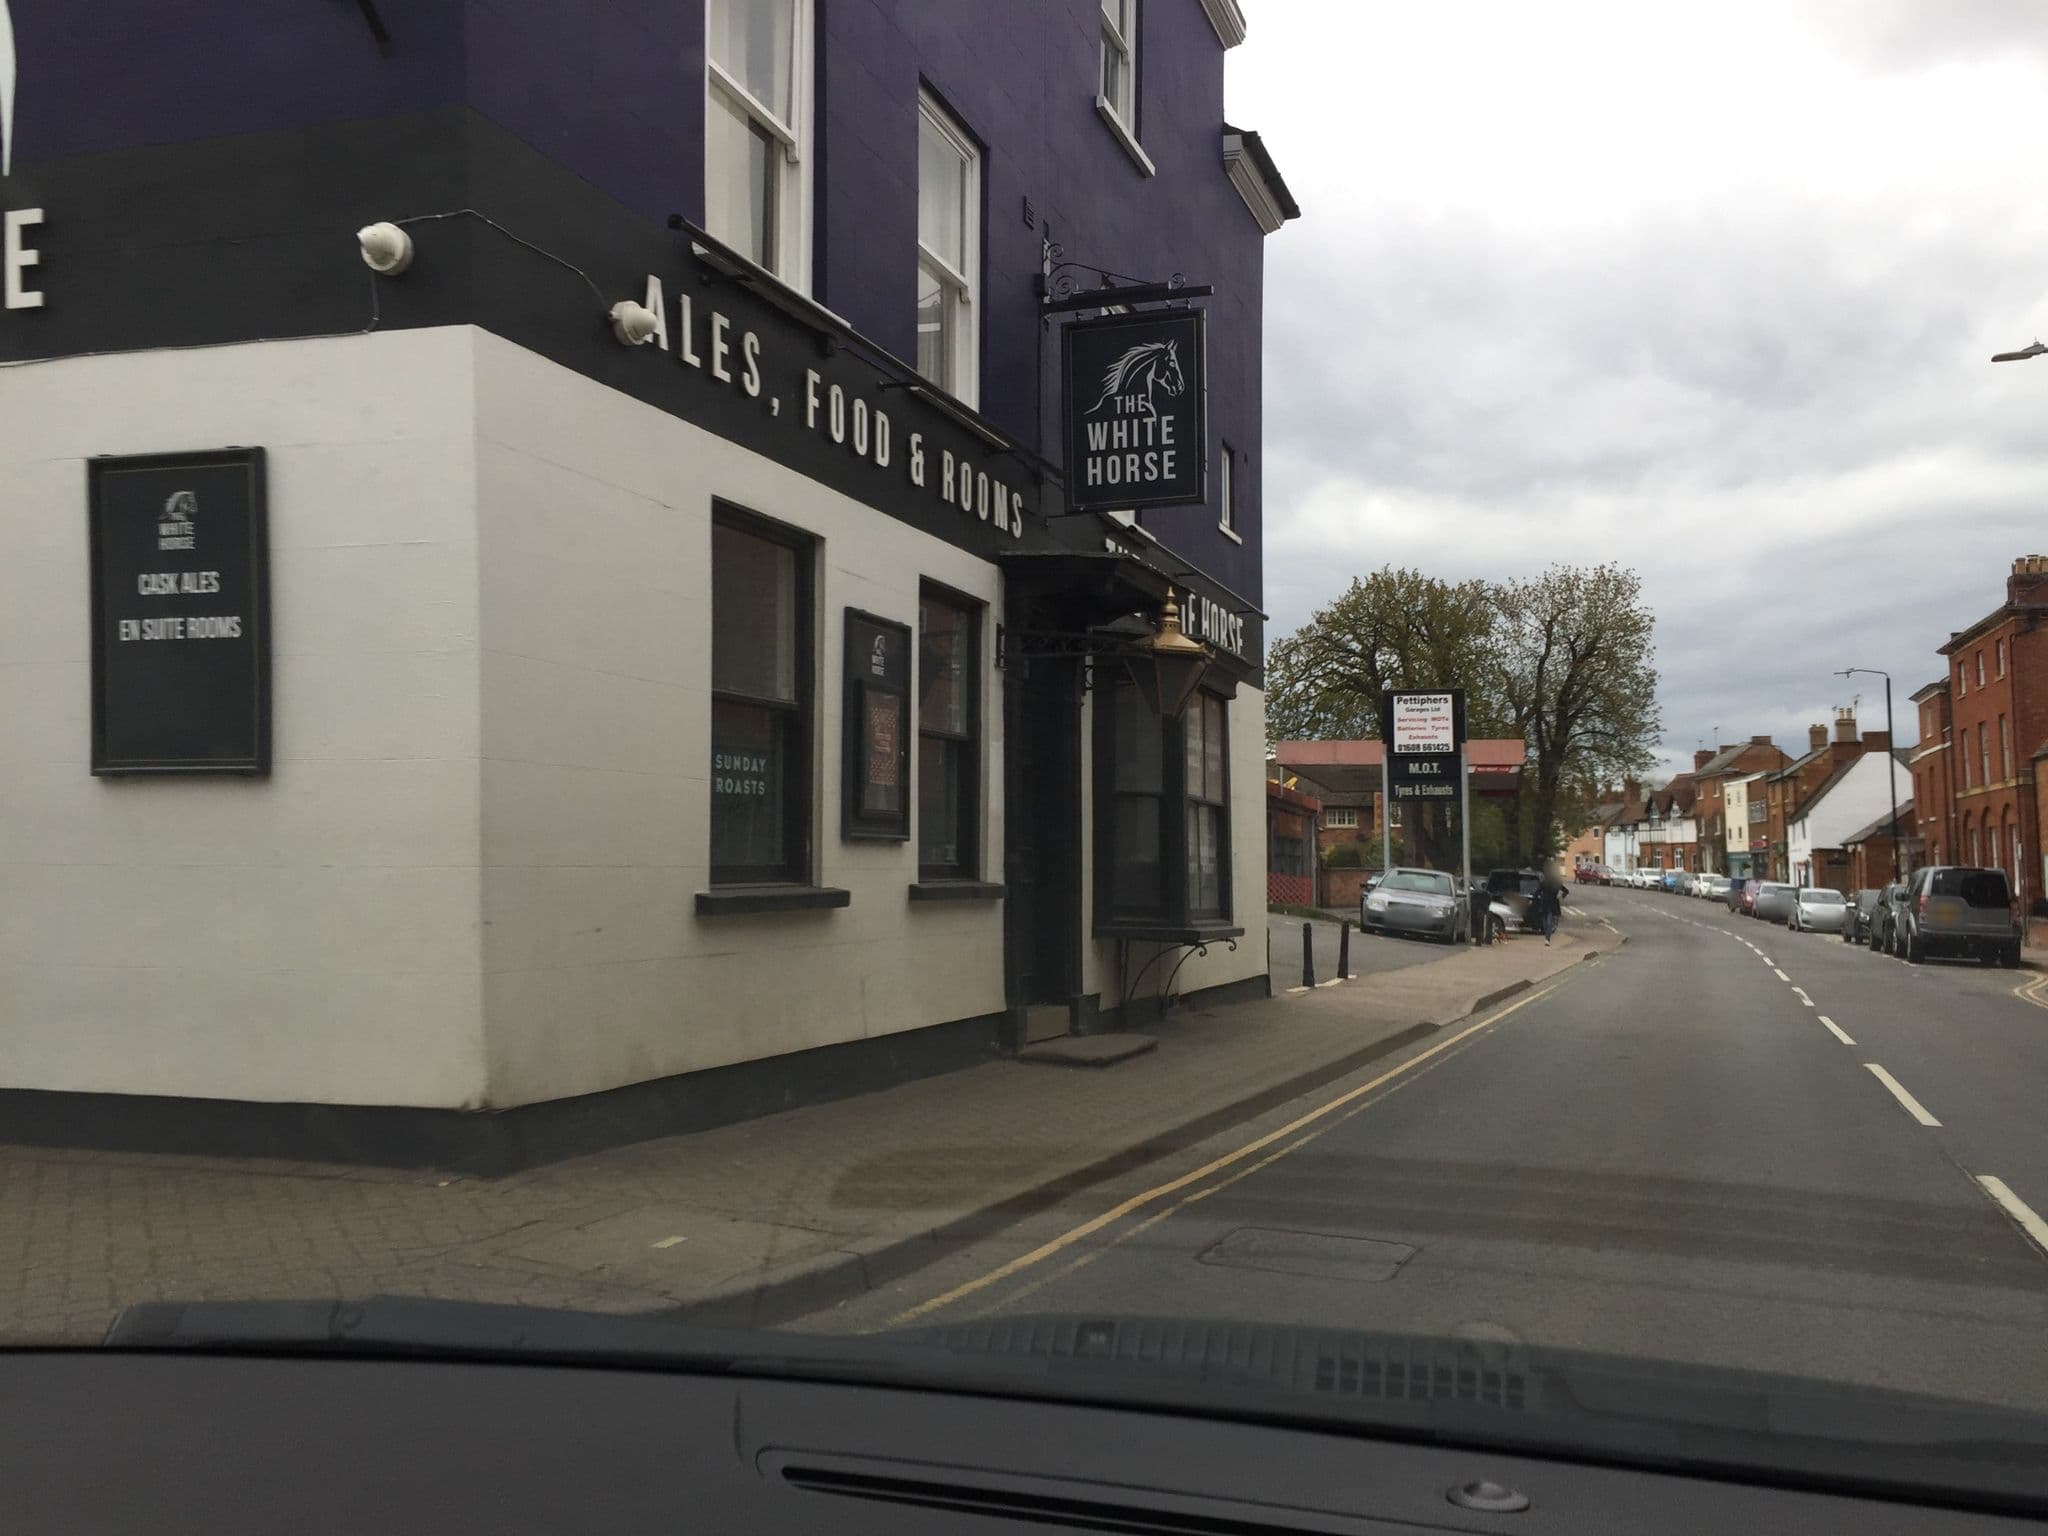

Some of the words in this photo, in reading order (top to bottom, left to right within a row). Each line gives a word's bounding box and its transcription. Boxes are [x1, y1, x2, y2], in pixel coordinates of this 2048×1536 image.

[1114, 394, 1146, 414] THE
[1087, 415, 1175, 451] WHITE
[806, 367, 890, 468] FOOD
[910, 432, 925, 487] &
[941, 449, 1023, 539] ROOMS
[1087, 450, 1177, 486] HORSE
[119, 619, 140, 641] EN
[142, 617, 185, 640] SUITE
[186, 616, 242, 639] ROOMS
[1396, 696, 1449, 706] Pettiphers
[715, 754, 768, 773] SUNDAY
[1408, 763, 1441, 774] M.O.T.
[715, 777, 766, 796] ROASTS
[1395, 785, 1413, 798] Tyres
[1414, 785, 1420, 795] &
[1421, 784, 1454, 795] Exhausts
